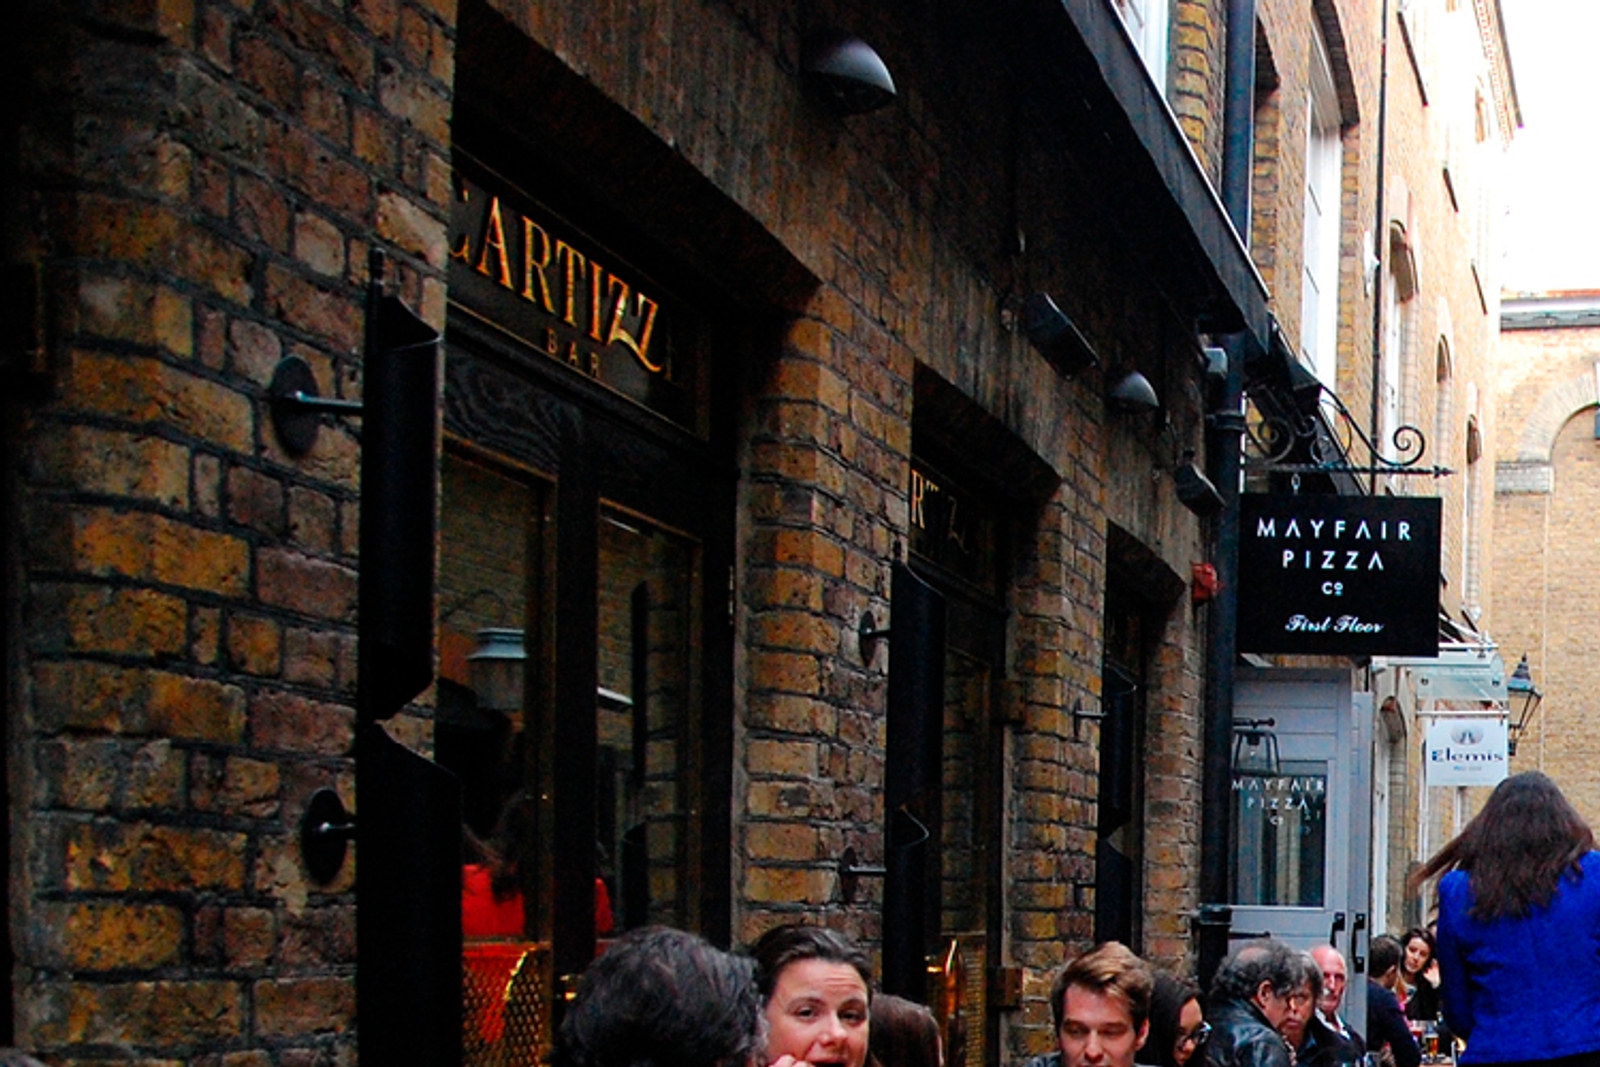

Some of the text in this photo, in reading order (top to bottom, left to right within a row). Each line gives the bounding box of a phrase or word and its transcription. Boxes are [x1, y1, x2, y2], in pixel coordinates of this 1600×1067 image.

[547, 327, 600, 378] BAR
[1256, 516, 1412, 542] MAYFAIR
[1282, 549, 1384, 571] PIZZA
[1284, 614, 1385, 633] First Floor
[1431, 747, 1504, 762] Elemis
[1231, 779, 1325, 793] MAYFAIR
[1247, 797, 1308, 810] PIZZA
